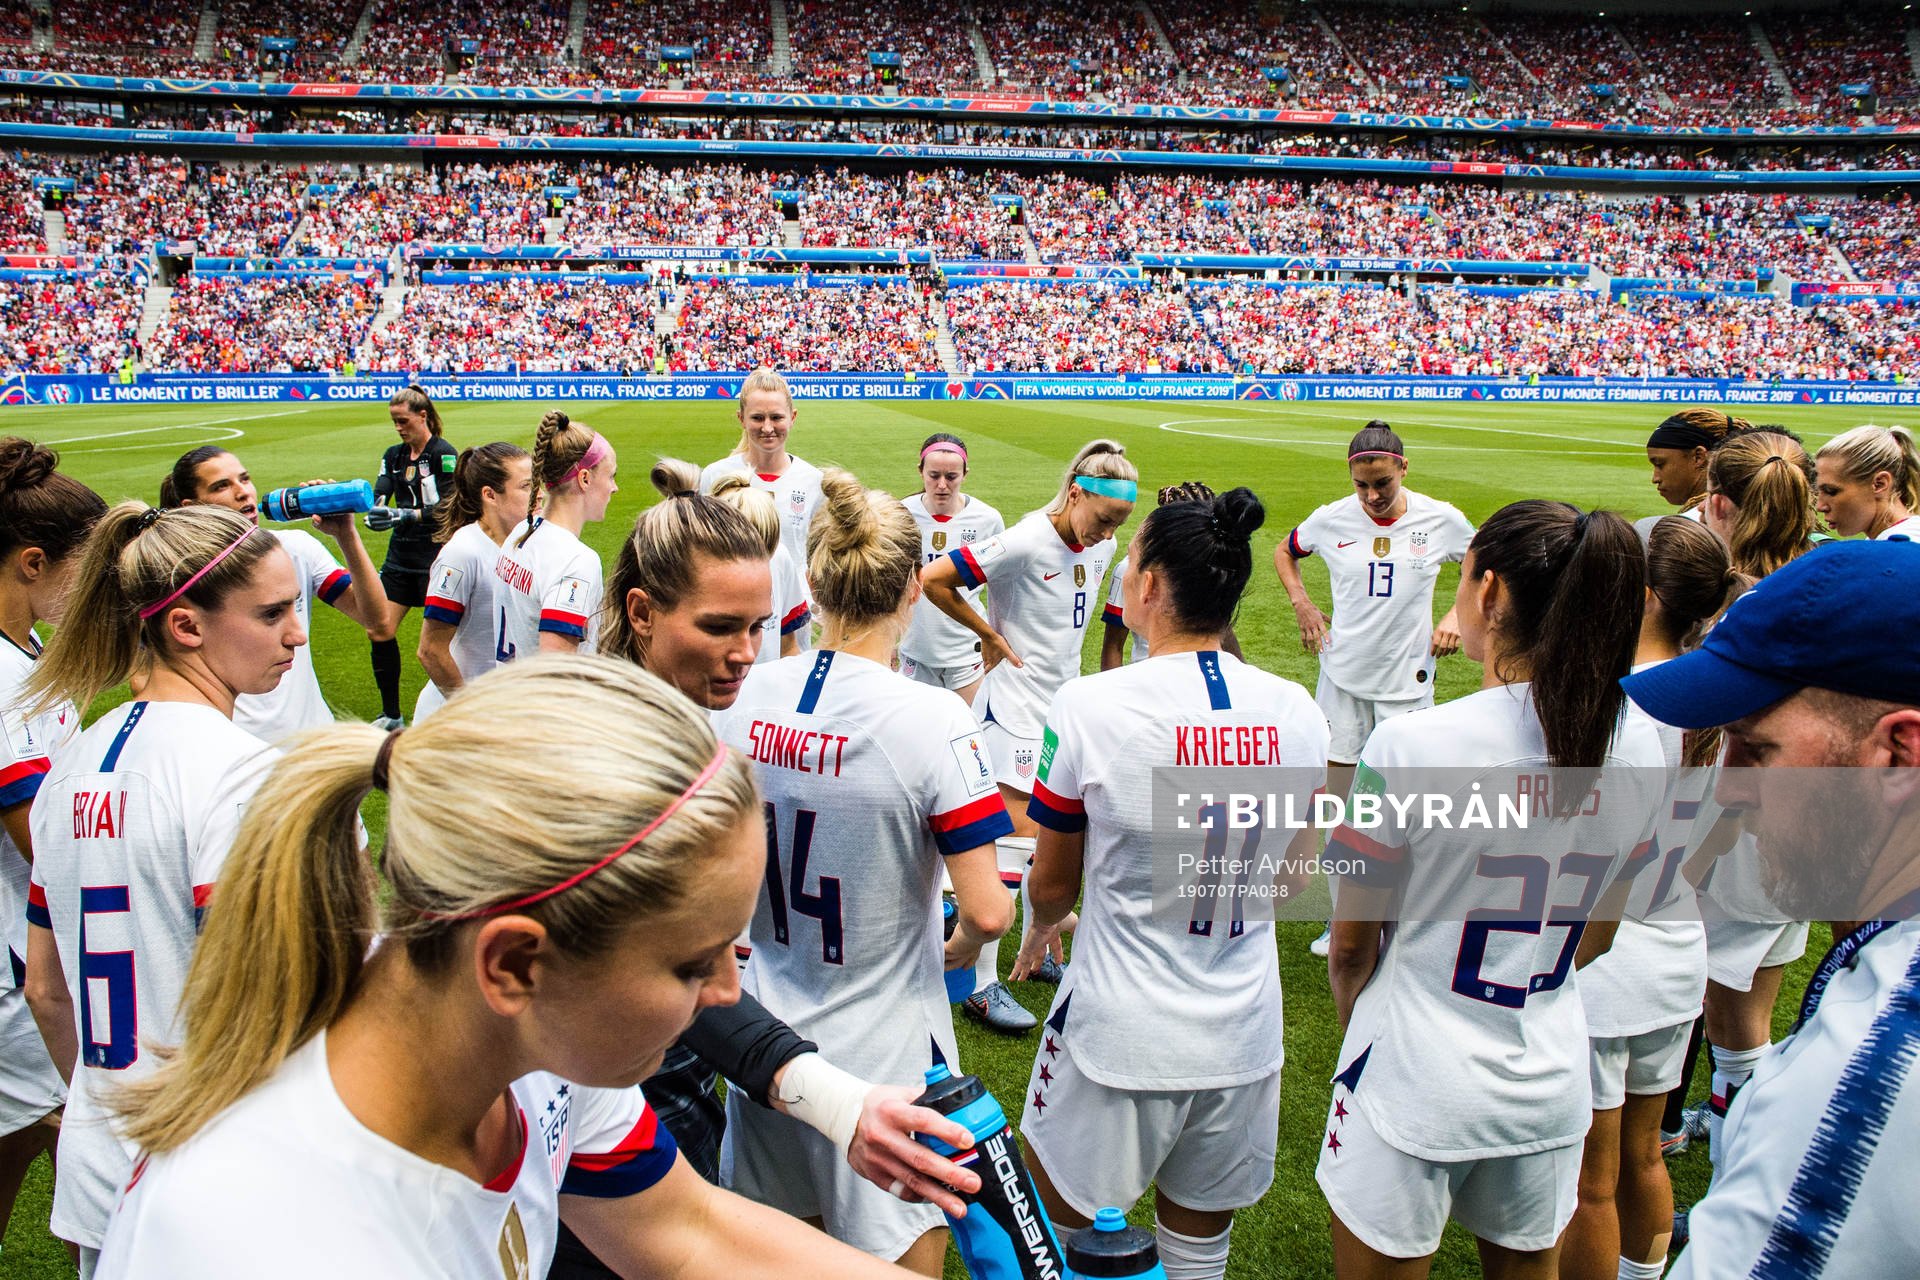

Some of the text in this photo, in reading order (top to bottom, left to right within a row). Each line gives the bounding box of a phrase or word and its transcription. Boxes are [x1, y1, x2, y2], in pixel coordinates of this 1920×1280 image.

[458, 138, 479, 146] LYON
[928, 147, 1070, 160] FIFA WOMEN'S WORLD CUP FRANCE 2019
[1469, 165, 1488, 173] LYON
[618, 248, 721, 258] LE MOMENT DE BRILLER
[1340, 260, 1397, 269] DARE TO SHINE
[91, 385, 279, 401] LE MOMENT DE BRILLER
[328, 385, 378, 400] COUPE
[422, 385, 461, 398] ONDE
[464, 383, 532, 399] FÉMININE
[536, 384, 555, 398] DE
[559, 384, 578, 398] LA
[581, 384, 614, 399] FIFA,
[617, 384, 673, 399] FRANCE
[675, 384, 706, 398] 2019
[789, 384, 921, 398] OMENT DE BRILLER
[1016, 385, 1230, 397] FIFA WOMEN'S WORLD CUP FRANCE 2019
[1315, 386, 1463, 399] LE MOMENT DE BRILLER
[1501, 386, 1794, 402] COUPE DU MONDE FÉMININE DE LA FIFA, FRANCE 2019
[1829, 391, 1841, 402] LE
[1841, 391, 1895, 403] MOMENT
[1897, 392, 1914, 403] DE
[962, 534, 976, 542] USA
[1411, 537, 1427, 547] USA
[1368, 561, 1394, 598] 13
[1074, 592, 1086, 629] 8
[746, 719, 849, 778] SONNETT
[1175, 725, 1281, 766] KRIEGER
[1016, 755, 1032, 766] USA
[74, 790, 128, 839] BRIAN
[1188, 800, 1264, 939] 11
[763, 801, 844, 966] 14
[1451, 852, 1616, 1009] 23
[1814, 917, 1882, 991] FIFA WOMENS
[80, 885, 139, 1070] 6
